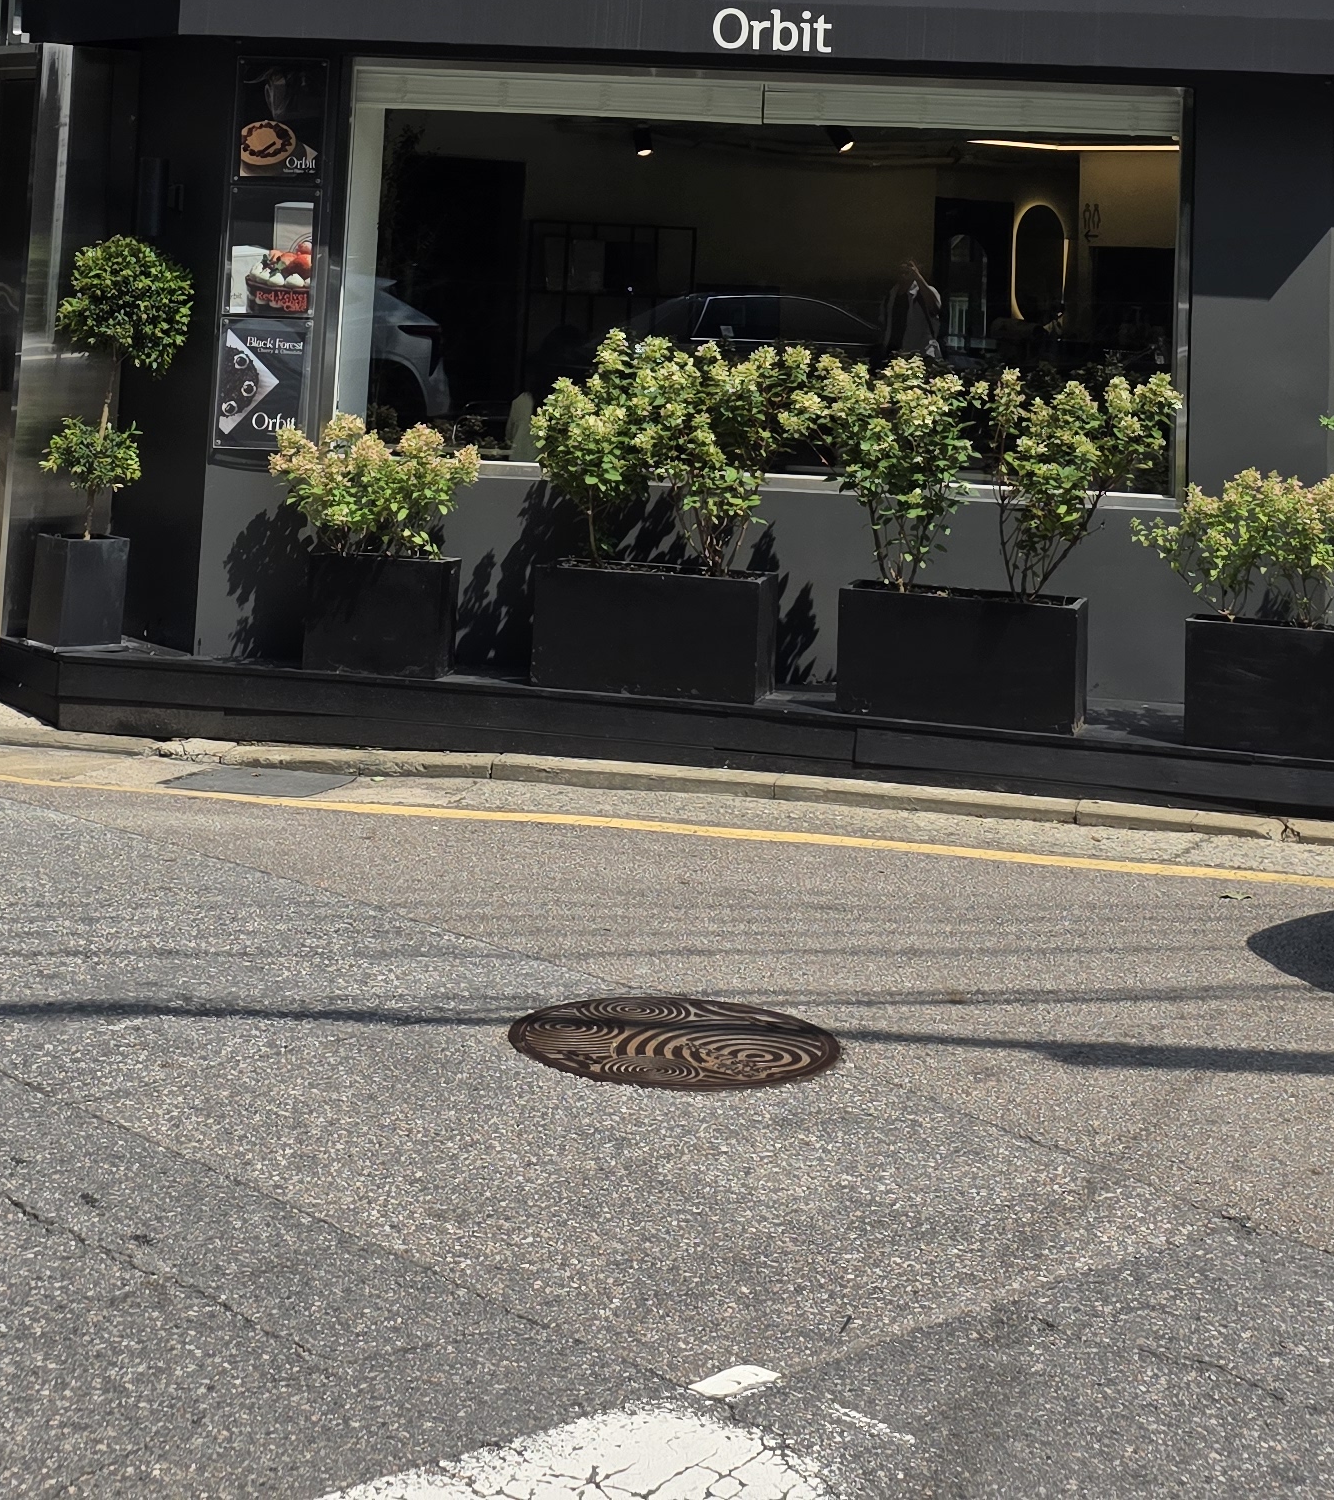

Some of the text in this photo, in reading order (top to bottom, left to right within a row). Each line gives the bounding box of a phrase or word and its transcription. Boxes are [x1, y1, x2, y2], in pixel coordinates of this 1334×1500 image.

[712, 7, 833, 53] Orbit
[285, 156, 316, 169] Orbit
[256, 290, 308, 302] Red Velvet
[247, 336, 304, 350] Black Forest
